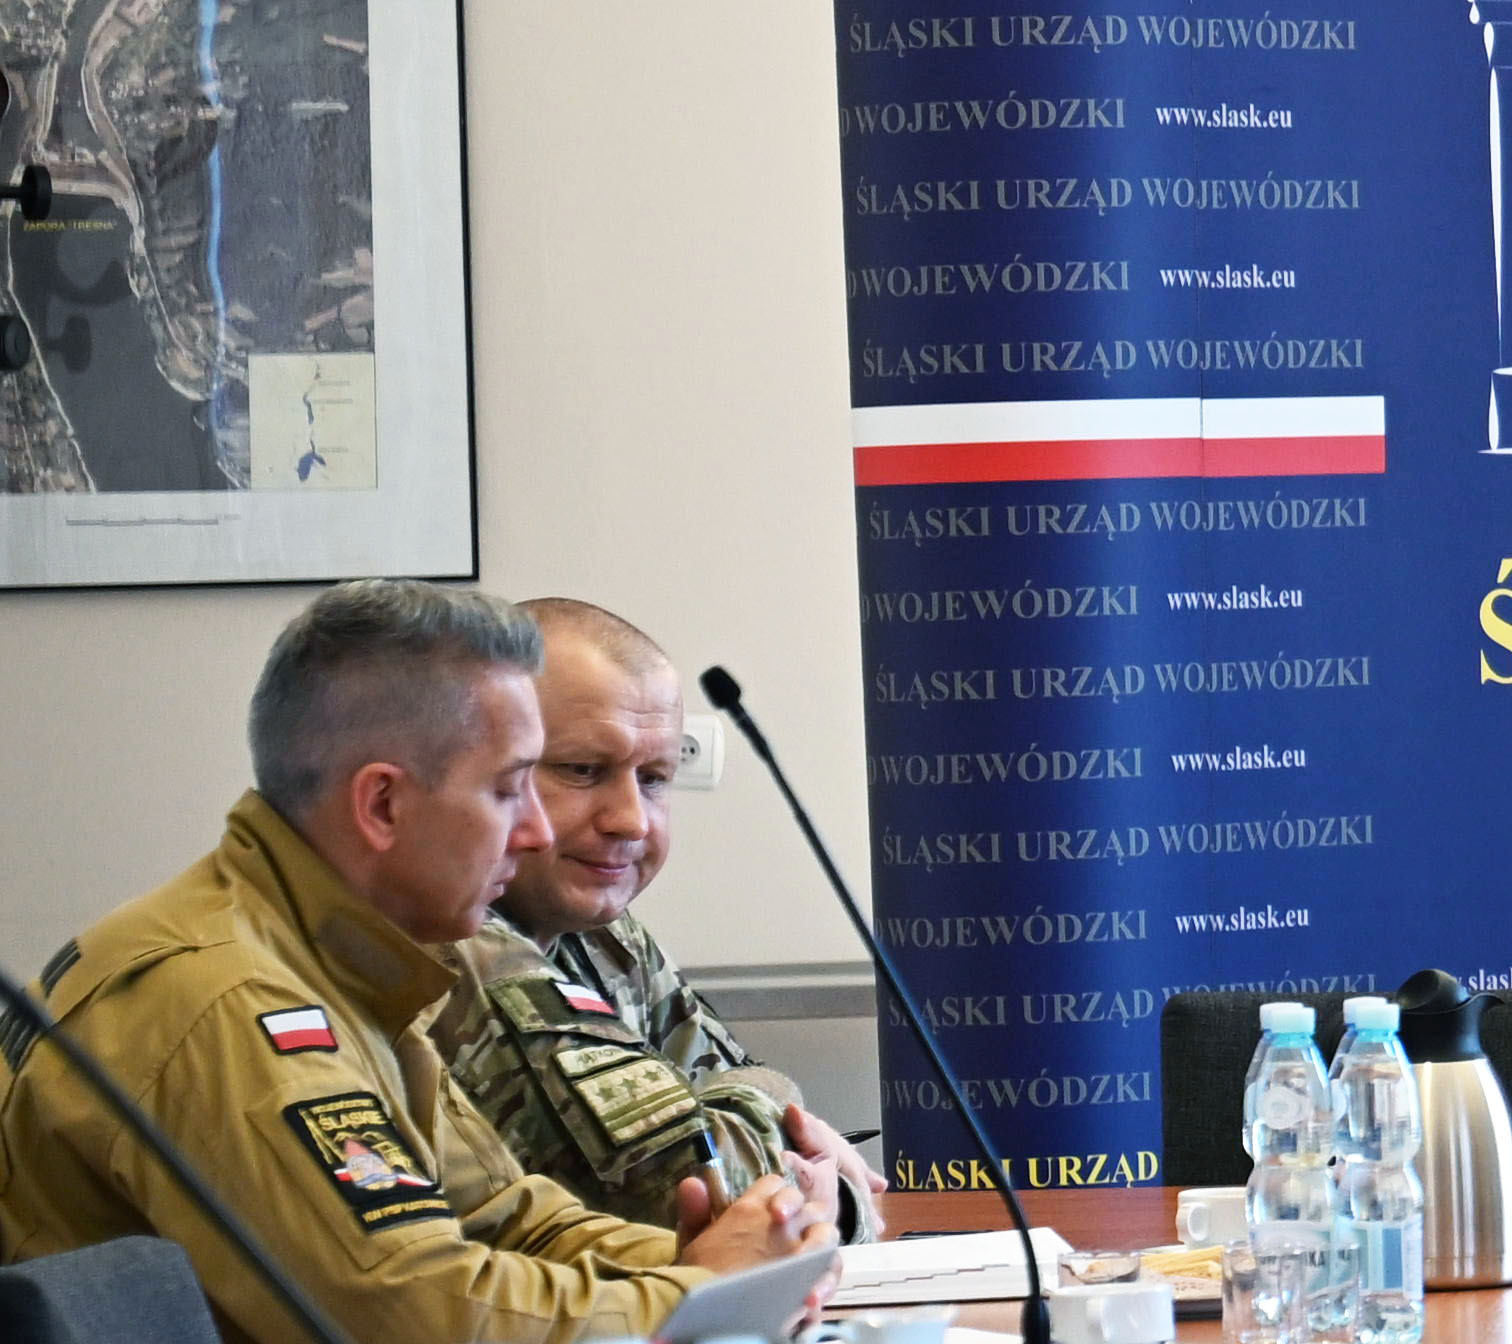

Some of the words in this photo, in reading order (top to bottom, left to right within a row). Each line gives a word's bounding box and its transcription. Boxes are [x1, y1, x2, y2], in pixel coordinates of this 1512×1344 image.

[850, 14, 973, 58] ŚLĄSKI
[991, 15, 1127, 53] URZĄD
[1138, 11, 1355, 49] WOJEWÓDZKI
[855, 90, 1125, 133] WOJEWÓDZKI
[1156, 103, 1292, 128] www.slask.eu
[857, 176, 979, 221] ŚLĄSKI
[996, 178, 1132, 216] URZĄD
[1142, 171, 1359, 209] WOJEWÓDZKI
[862, 253, 1129, 296] WOJEWÓDZKI
[1160, 264, 1295, 288] www.slask.eu
[864, 339, 985, 384] ŚLĄSKI
[1002, 341, 1136, 378] URZĄD
[1146, 331, 1363, 370] WOJEWÓDZKI
[870, 502, 989, 547] ŚLĄSKI
[1007, 503, 1140, 541] URZĄD
[1150, 491, 1366, 531] WOJEWÓDZKI
[875, 579, 1137, 622] WOJEWÓDZKI
[1168, 584, 1302, 610] www.slask.eu
[876, 664, 995, 709] ŚLĄSKI
[1012, 665, 1145, 704] URZĄD
[1154, 651, 1369, 692] WOJEWÓDZKI
[881, 743, 1142, 784] WOJEWÓDZKI
[1172, 745, 1305, 771] www.slask.eu
[883, 826, 1001, 873] ŚLĄSKI
[1017, 827, 1149, 866] URZĄD
[1158, 811, 1372, 854] WOJEWÓDZKI
[888, 906, 1147, 949] WOJEWÓDZKI
[1176, 905, 1309, 932] www.slask.eu
[1022, 989, 1153, 1028] URZĄD
[1027, 1151, 1159, 1188] URZĄD
